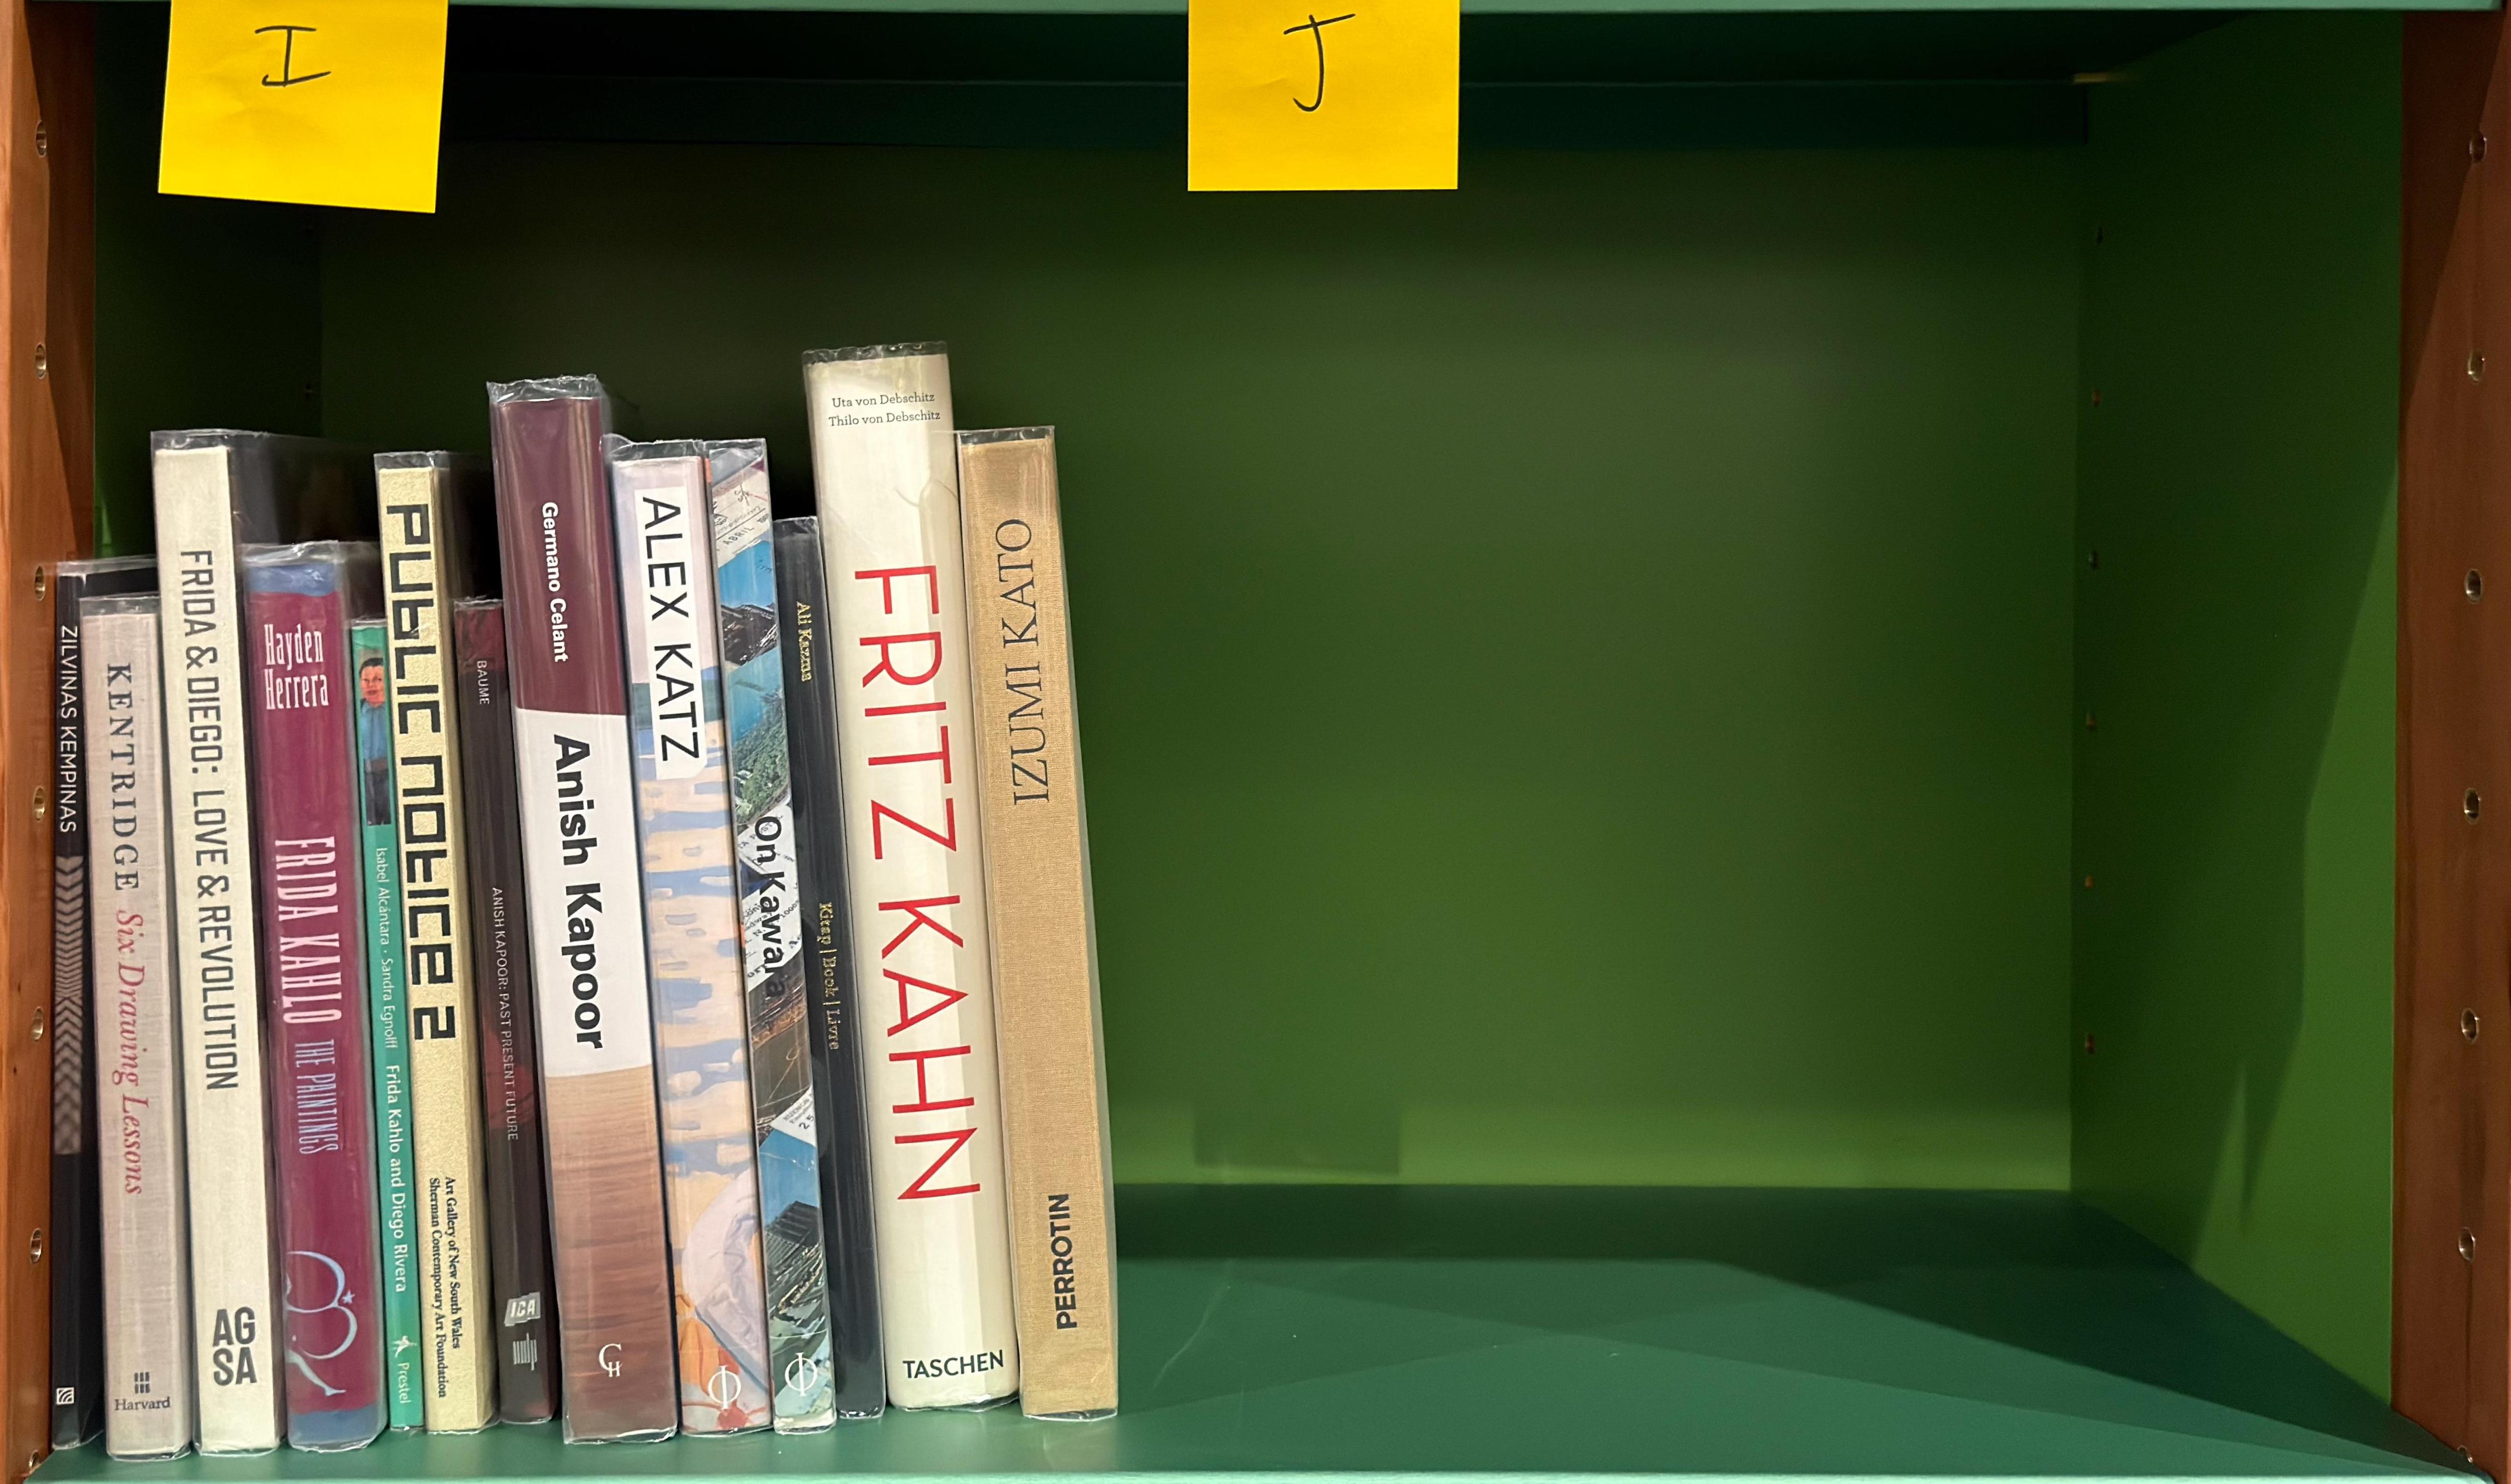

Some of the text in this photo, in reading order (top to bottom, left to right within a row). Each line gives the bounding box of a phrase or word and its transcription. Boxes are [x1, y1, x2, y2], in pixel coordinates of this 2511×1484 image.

[1283, 13, 1356, 112] J
[828, 410, 941, 426] Thilo von Debschitz
[832, 392, 935, 408] Uta von Debschitz
[542, 501, 569, 662] Germano Celant
[264, 623, 324, 670] Hayden
[643, 496, 700, 762] ALEX KATZ
[796, 601, 812, 682] Ali Kazma
[995, 518, 1050, 806] IZUMI KATO
[264, 669, 329, 710] Herrera
[477, 660, 490, 704] BAUME
[59, 625, 78, 833] ZILVINAS KEMPINAS
[181, 550, 239, 1090] FRIDA & DIEGO: LOVE & REVOLUTION
[754, 816, 782, 863] On
[554, 734, 603, 1050] Anish Kapoor
[854, 565, 981, 1199] FRITZ KAHN
[107, 663, 149, 1195] KENTRIDGE Six Drawing Lessons
[275, 836, 342, 1155] FRIDA KAHLO THE PAINTINGS
[492, 887, 518, 1140] ANISH KAPOOR: PAST PRESENT FUTURE
[823, 956, 839, 997] Book
[414, 1006, 455, 1041] 2
[826, 1009, 841, 1050] Livre
[376, 848, 408, 1292] Isabel Alcántara Sandra Egnolff Frida Kahlo and Diego Rivera
[429, 1178, 448, 1398] Sherman Contemporary Art Foundation
[445, 1177, 462, 1349] Art Gallery of New South Wales
[1048, 1193, 1077, 1330] PERROTIN
[213, 1307, 256, 1347] AG
[510, 1299, 536, 1318] ICA
[114, 1396, 171, 1412] Harvard
[214, 1348, 257, 1386] SA
[397, 1363, 411, 1403] Prestel
[902, 1350, 1005, 1380] TASCHEN
